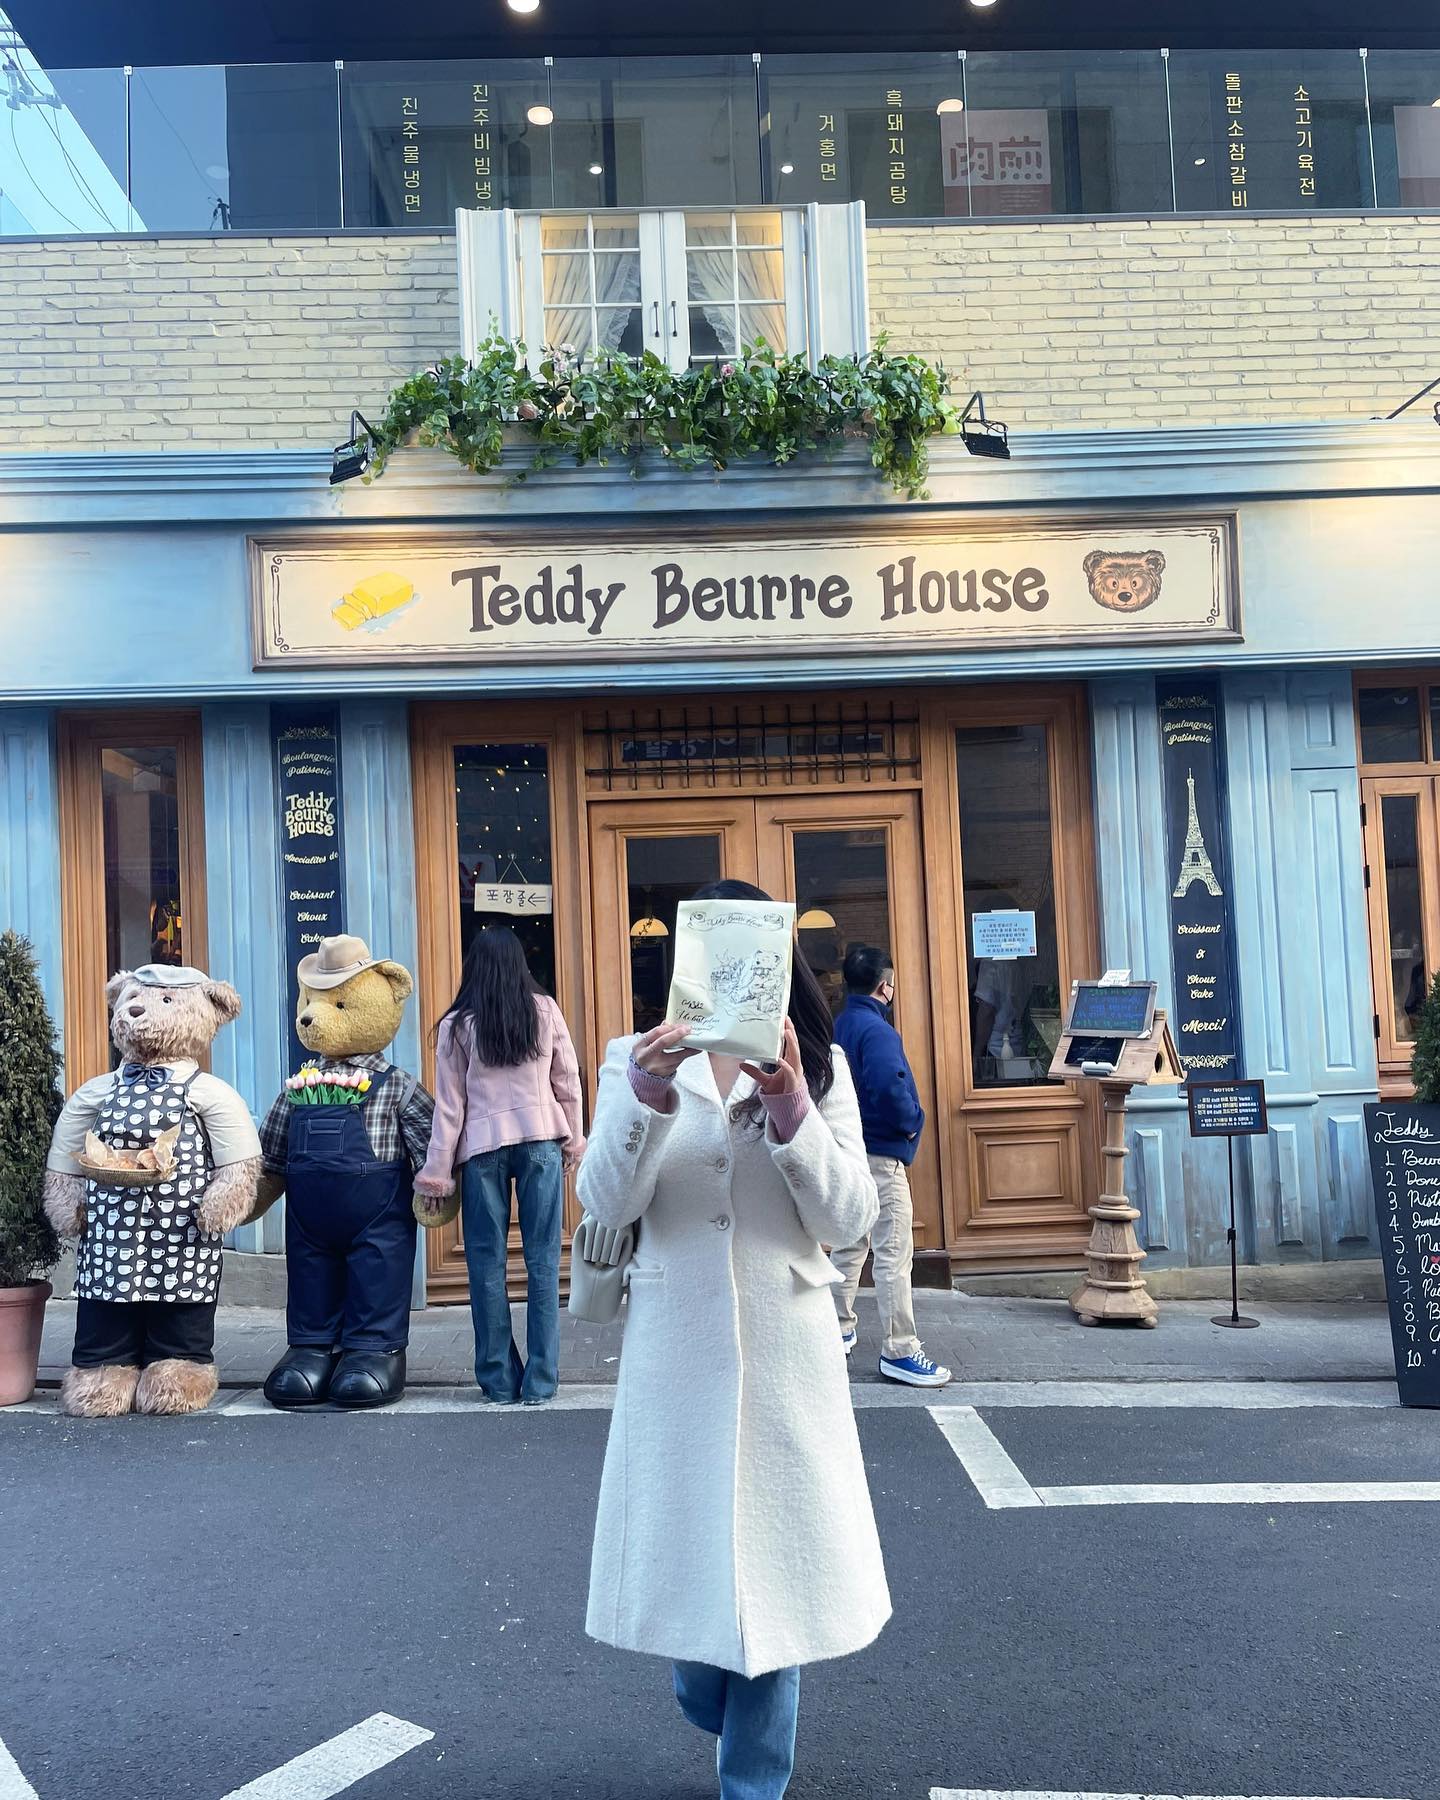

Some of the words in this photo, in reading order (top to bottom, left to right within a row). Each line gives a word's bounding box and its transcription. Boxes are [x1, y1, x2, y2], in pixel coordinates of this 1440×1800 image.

[472, 84, 492, 211] 진주비빔냉
[819, 114, 836, 181] 거홍면
[886, 89, 908, 204] 흑돼지곰탕
[1225, 73, 1248, 208] 돌판소참갈비
[1294, 85, 1315, 196] 소고기육전
[402, 97, 420, 213] 진주물냉면
[451, 563, 626, 636] Teddy
[650, 563, 855, 630] Beurre
[880, 555, 1051, 621] House
[1163, 719, 1214, 733] Boulangerie
[1167, 732, 1212, 746] Patisserie
[281, 751, 336, 765] Boulangerie
[285, 765, 333, 778] Patisserie
[286, 790, 335, 812] Teddy
[285, 808, 336, 827] Beurre
[289, 889, 336, 901] Croissant
[297, 911, 328, 922] Choux
[1177, 924, 1221, 935] Croissant
[300, 933, 325, 944] Cake
[1195, 948, 1206, 960] &
[1186, 974, 1217, 985] Choux
[1190, 989, 1214, 1000] Cake
[1181, 1017, 1227, 1035] Merci!
[1376, 1111, 1434, 1139] Teddy
[1385, 1150, 1396, 1167] 1
[1386, 1170, 1397, 1187] 2
